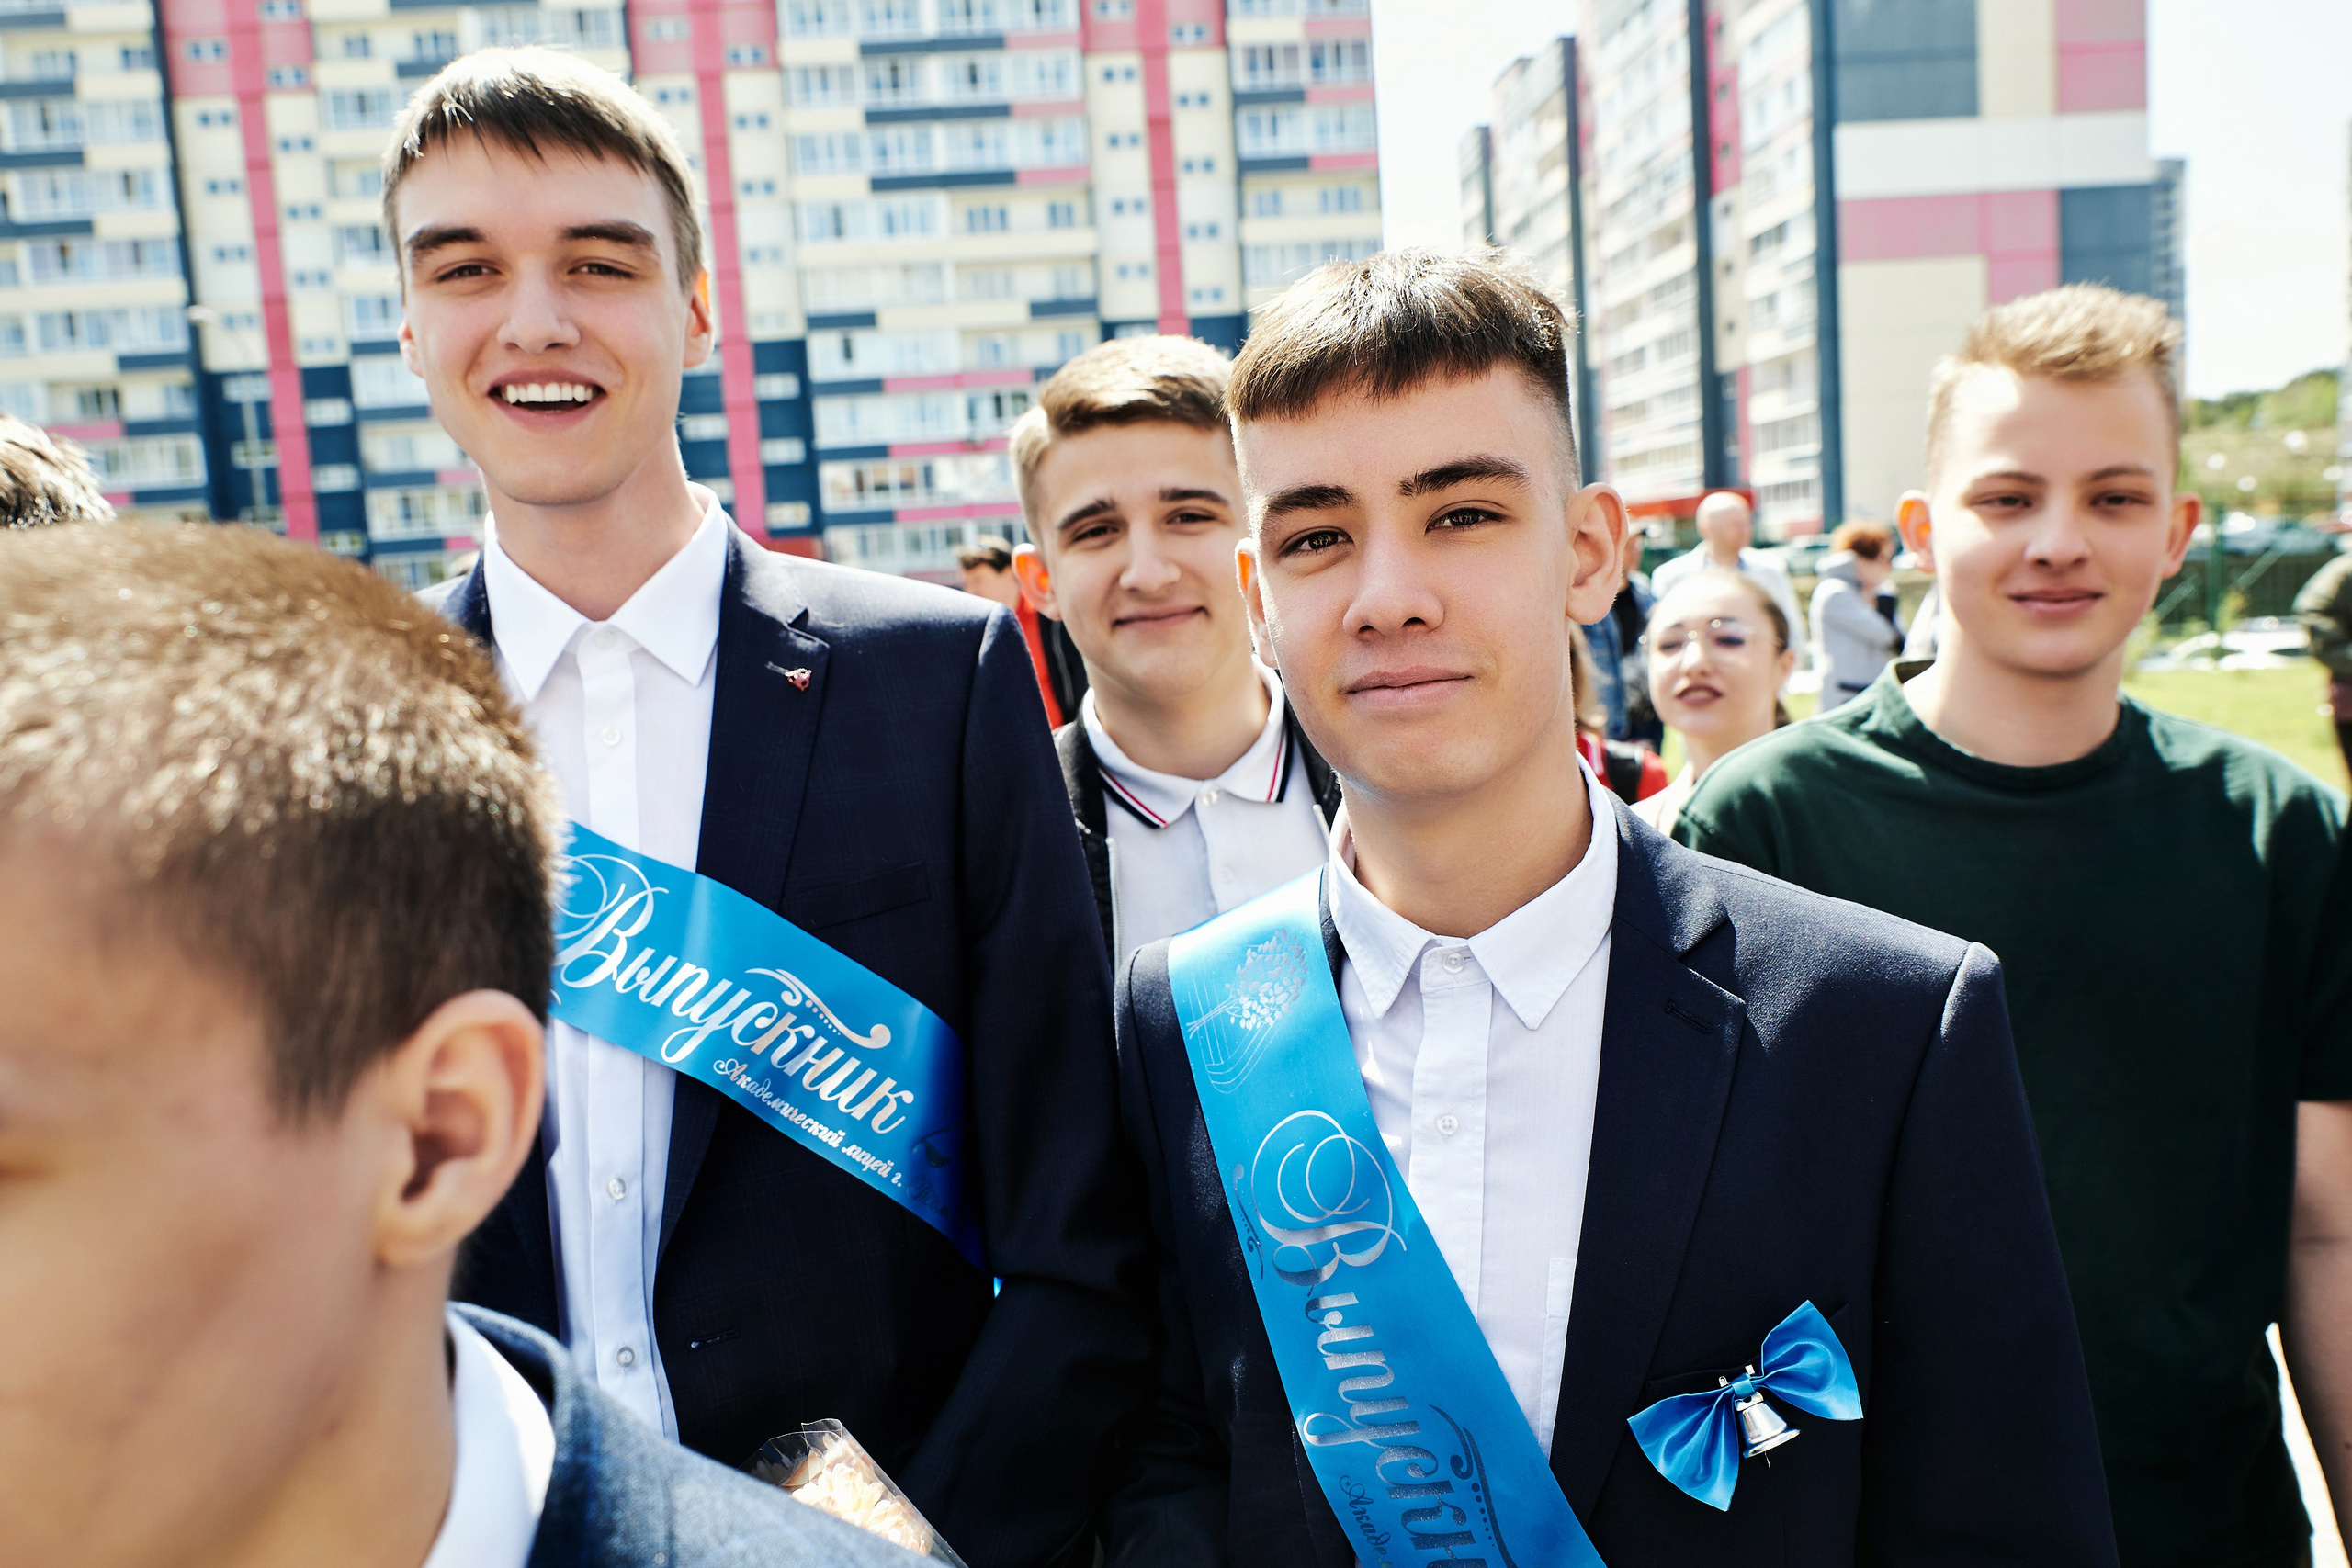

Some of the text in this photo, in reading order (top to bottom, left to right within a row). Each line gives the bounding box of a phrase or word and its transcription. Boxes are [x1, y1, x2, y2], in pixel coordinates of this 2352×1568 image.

[551, 853, 915, 1134] Выпускник
[713, 1058, 846, 1148] Академический
[842, 1144, 895, 1179] лицей
